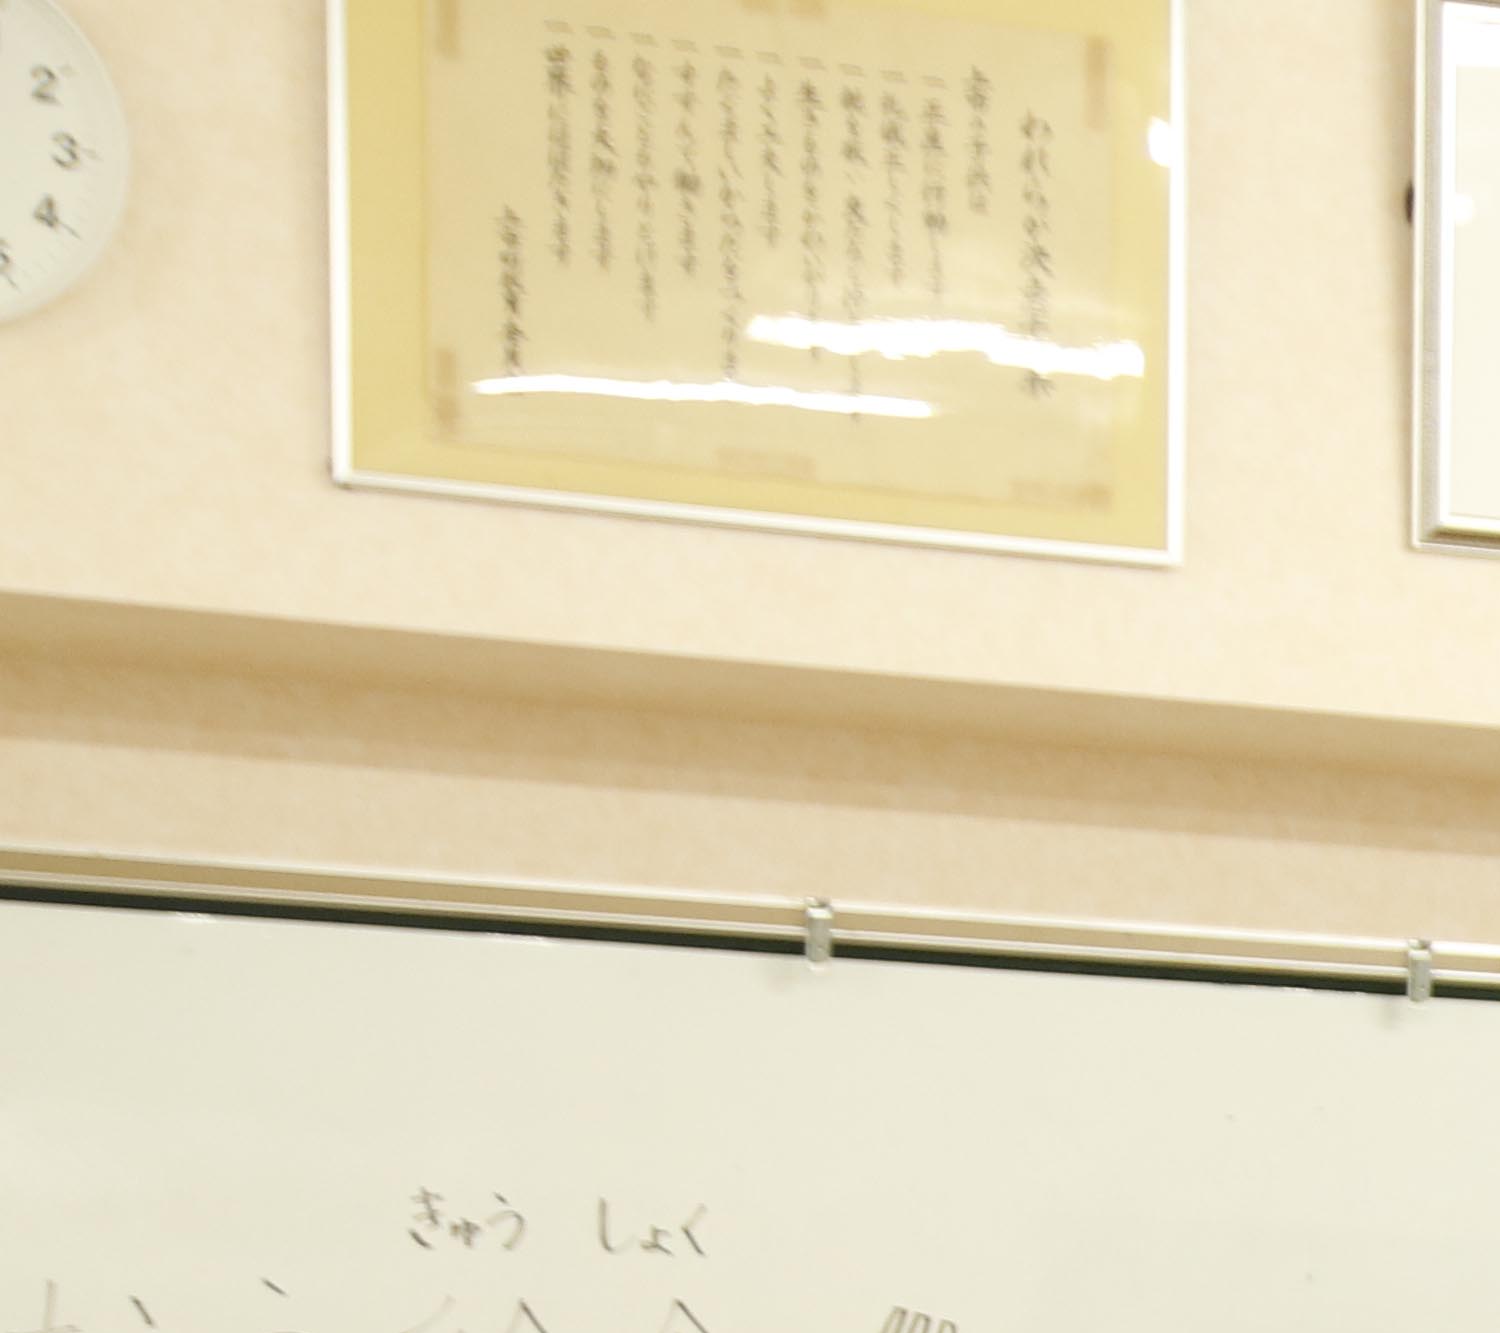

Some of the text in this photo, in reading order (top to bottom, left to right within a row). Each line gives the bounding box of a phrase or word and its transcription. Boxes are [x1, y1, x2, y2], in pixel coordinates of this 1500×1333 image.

[30, 64, 59, 105] 2
[51, 131, 79, 171] 3
[33, 192, 58, 229] 4
[407, 1186, 707, 1258] きゅう しょく
